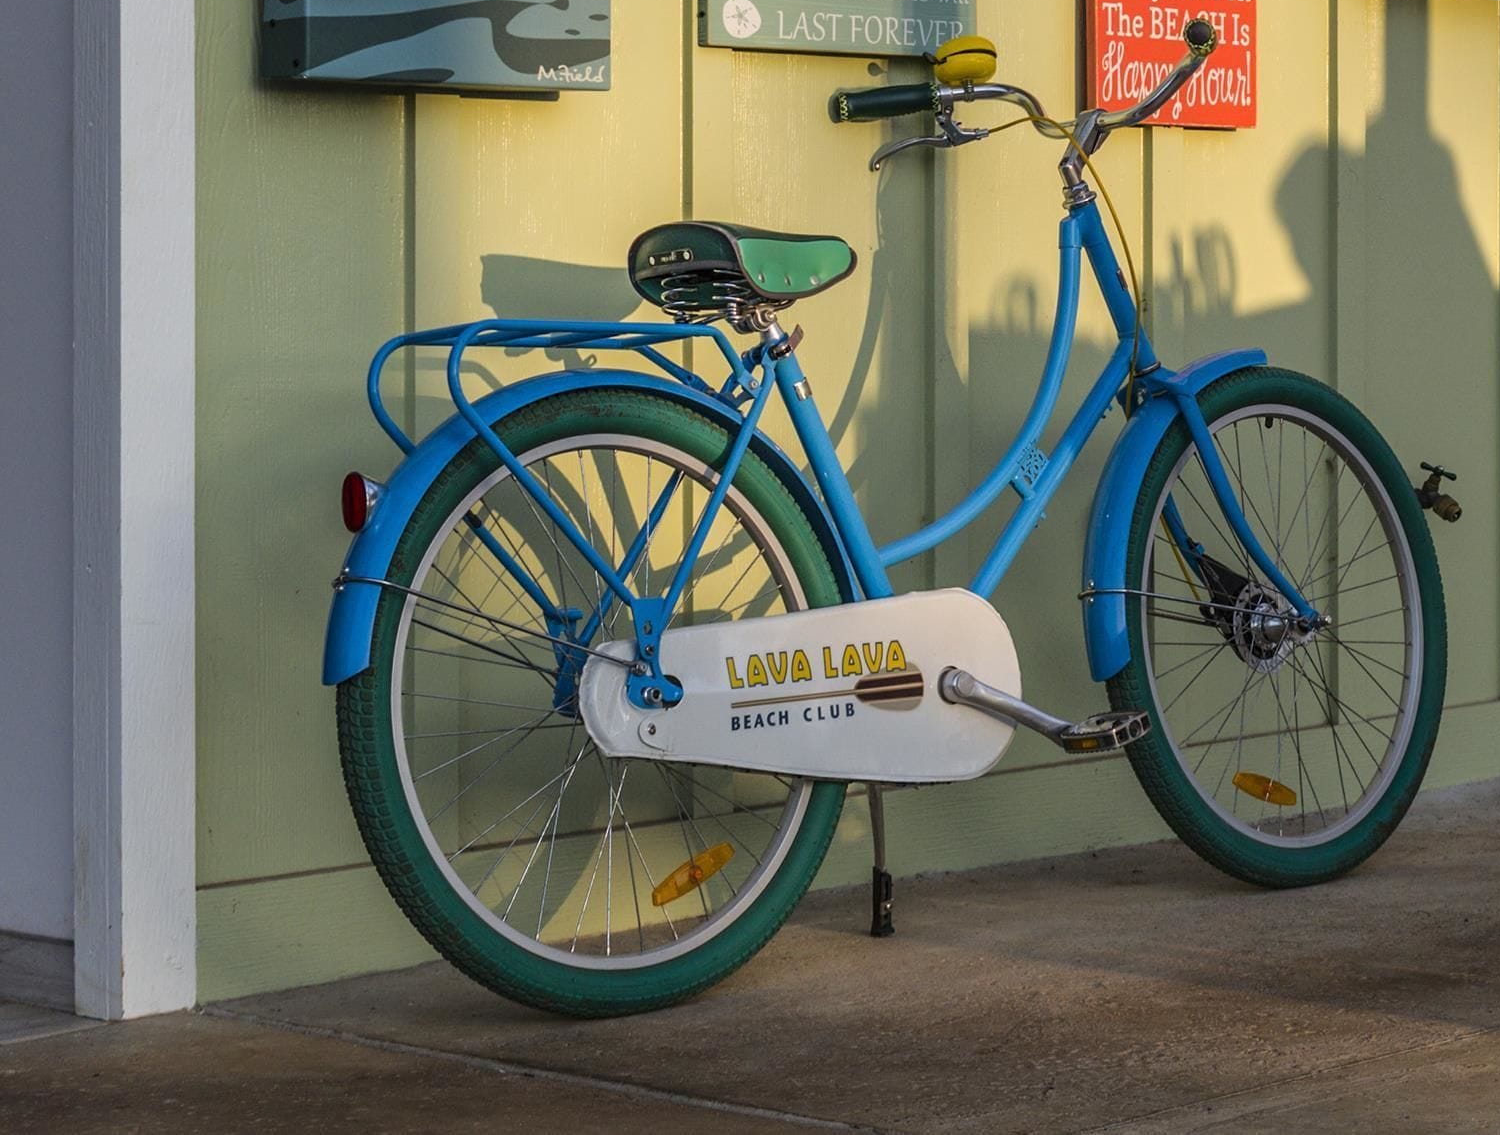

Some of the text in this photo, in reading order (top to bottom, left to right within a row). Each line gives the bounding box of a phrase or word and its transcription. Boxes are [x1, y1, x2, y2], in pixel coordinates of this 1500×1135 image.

[776, 10, 964, 47] LAST FOREVER
[1102, 2, 1250, 46] The BEAH Is
[726, 640, 907, 689] LAVA LAVA
[731, 703, 855, 731] BEACH CLUB
